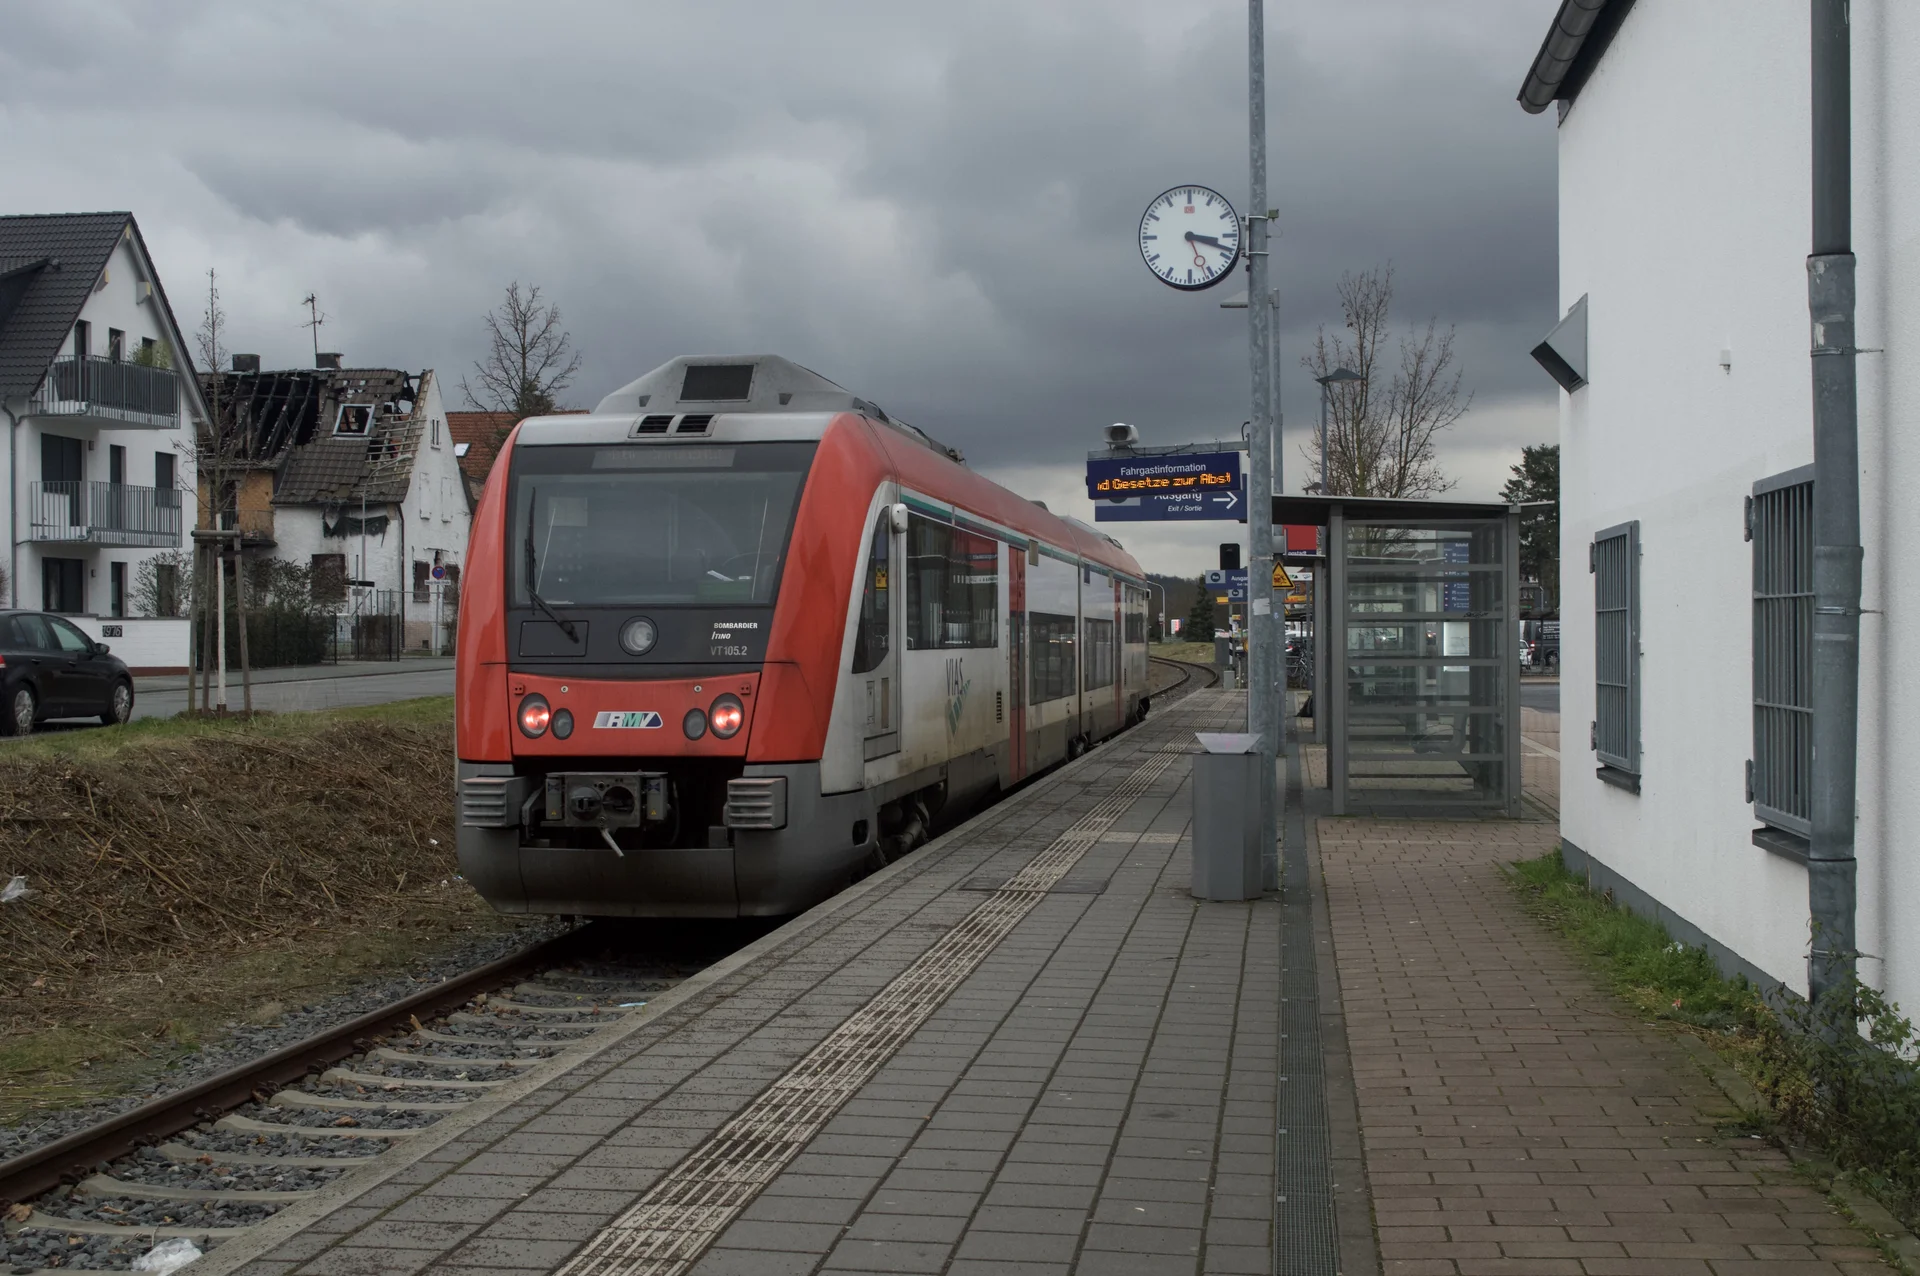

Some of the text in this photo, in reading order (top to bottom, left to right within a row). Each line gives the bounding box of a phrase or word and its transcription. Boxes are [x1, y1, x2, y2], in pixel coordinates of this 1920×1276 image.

[1120, 463, 1206, 476] Fahrgastinformation
[1112, 476, 1170, 490] Gesetze
[1172, 477, 1197, 486] zur
[1200, 472, 1231, 485] Abst
[1184, 504, 1203, 512] Sortie
[945, 656, 963, 697] VIAS
[605, 711, 654, 728] RMV
